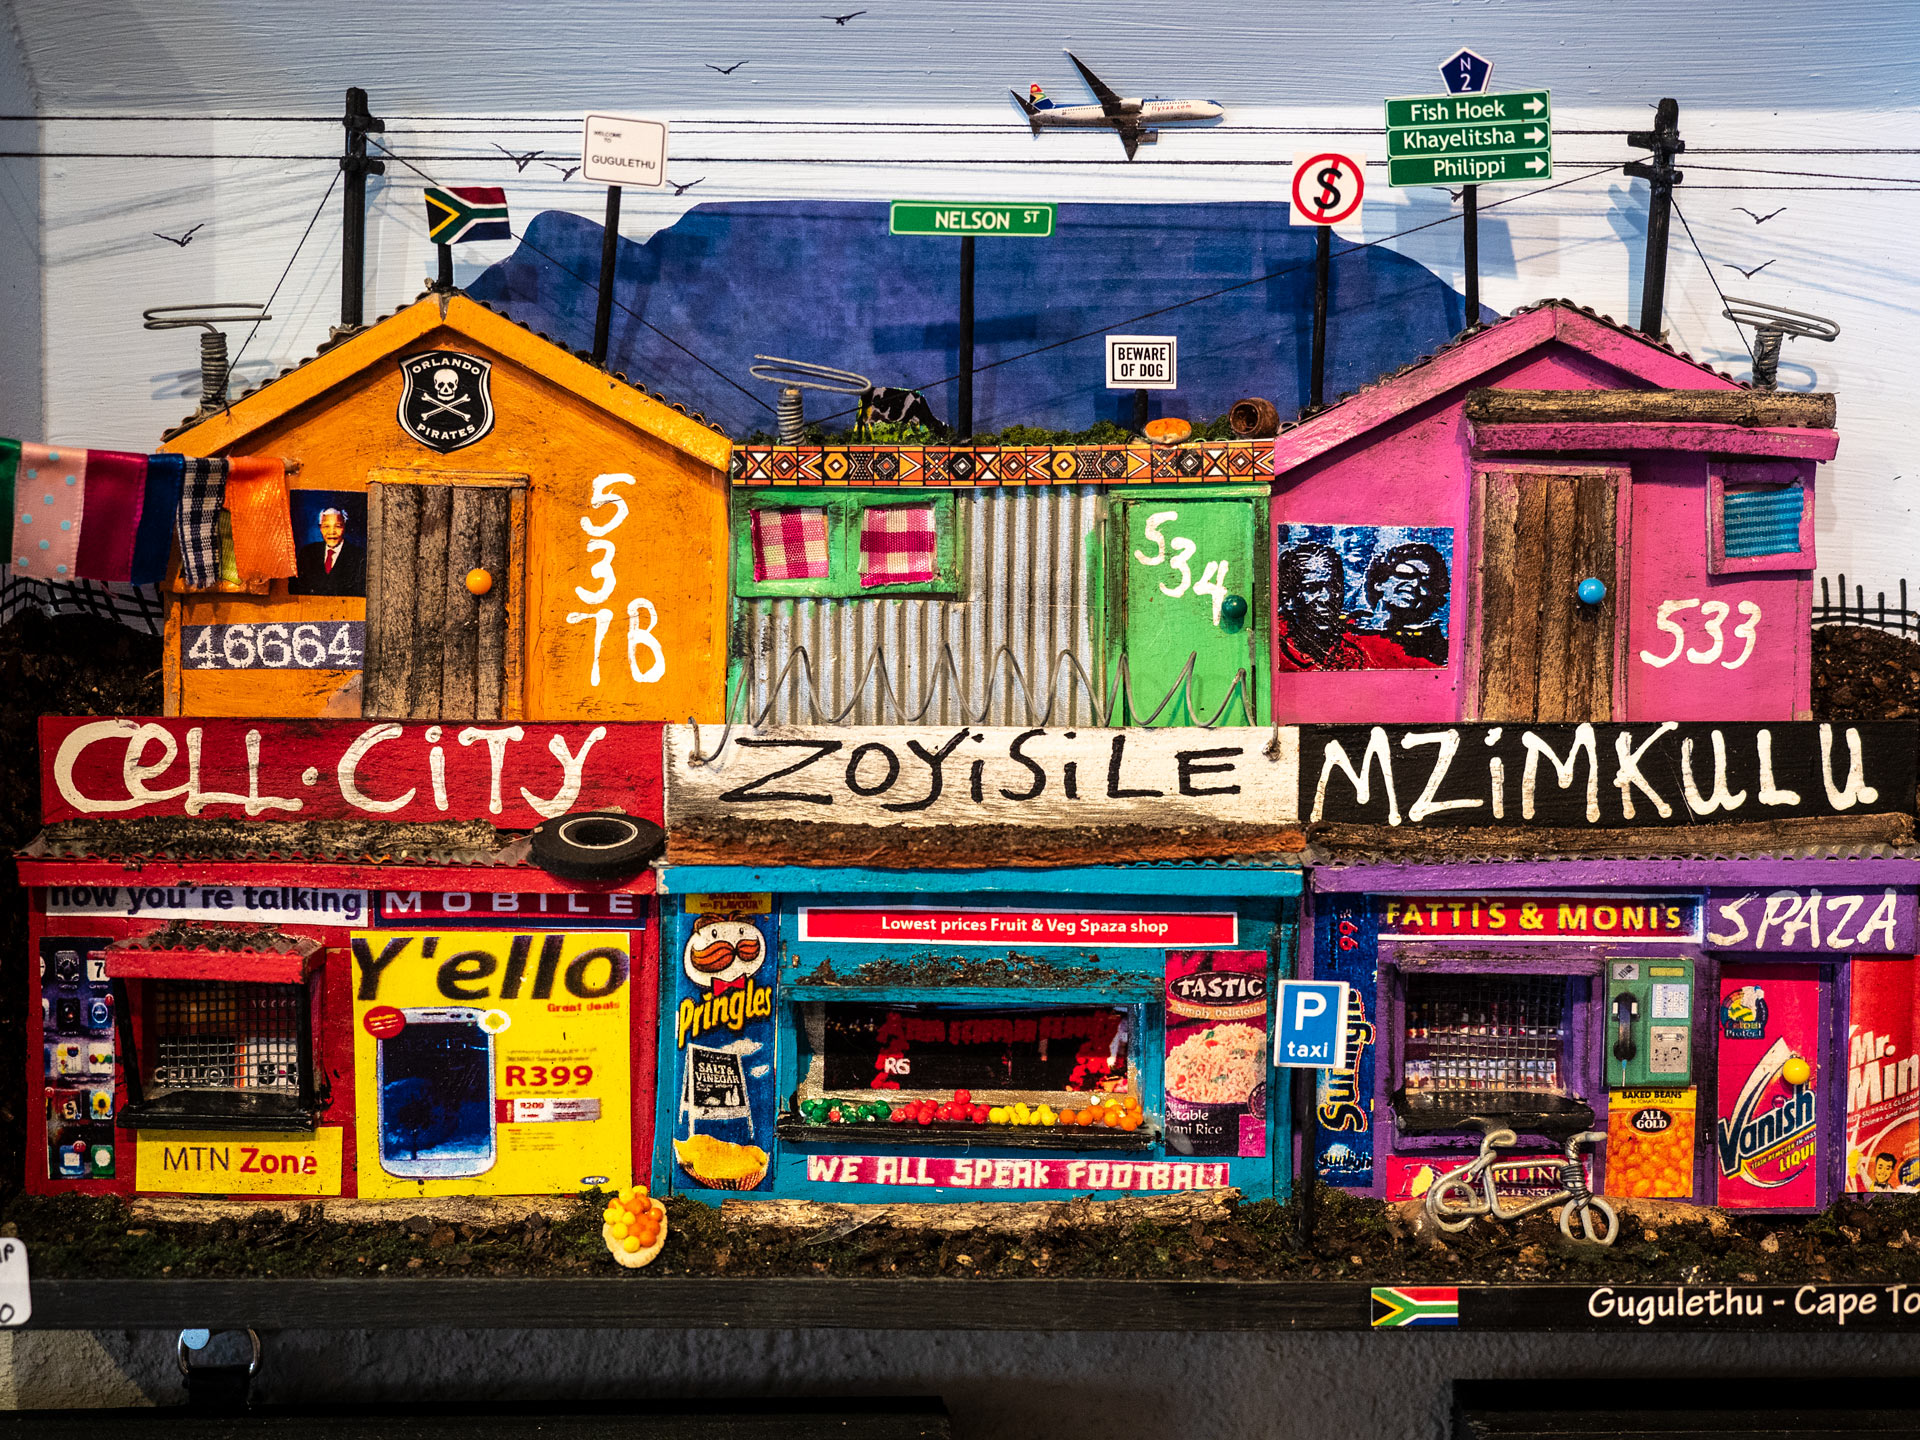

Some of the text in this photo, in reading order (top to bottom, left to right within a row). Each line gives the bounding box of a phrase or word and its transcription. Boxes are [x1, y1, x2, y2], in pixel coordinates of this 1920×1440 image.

[1459, 57, 1472, 72] N
[1460, 73, 1473, 91] 2
[1150, 103, 1192, 112] flysaa.com
[1410, 100, 1506, 121] Fish Hoek
[1403, 128, 1516, 152] Khayelitsha
[591, 155, 656, 170] GUGULETHU
[1433, 157, 1506, 178] Philippi
[1312, 167, 1343, 210] S
[935, 210, 1041, 230] NELSON ST
[1118, 347, 1166, 361] BEWARE
[412, 358, 480, 375] ORLANDO
[1121, 363, 1163, 377] OF DOG
[416, 423, 476, 440] PIRATES
[579, 473, 637, 537] 5
[574, 538, 618, 605] 3
[1133, 510, 1229, 627] 534
[1639, 598, 1762, 669] 533
[188, 622, 363, 669] 46664
[127, 886, 234, 915] you're
[243, 888, 361, 921] talking
[385, 891, 634, 914] MOBILE
[881, 915, 1168, 936] Lowest prices Fruit & Veg Spaza shop
[1518, 901, 1545, 930] &
[1706, 887, 1897, 951] SPAZA
[350, 935, 630, 1001] Y'ello
[1177, 977, 1263, 998] TASTIC
[546, 1000, 620, 1012] Great deals
[677, 978, 772, 1050] Pringles
[1176, 1004, 1261, 1018] Simply Delicious
[1294, 991, 1328, 1031] P
[1287, 1041, 1329, 1058] taxi
[1850, 1030, 1896, 1069] Mr.
[505, 1065, 593, 1087] R399
[884, 1057, 911, 1075] R6
[695, 1071, 740, 1084] VINEGAR
[1622, 1091, 1682, 1099] BAKED BEANS
[1636, 1119, 1667, 1129] GOLD
[1640, 1110, 1664, 1120] ALL
[1196, 1124, 1223, 1135] Rice
[1717, 1083, 1816, 1174] Vanish
[164, 1147, 318, 1175] MTN Zone
[809, 1156, 1228, 1191] WE ALL SPEAK FOOTBALL
[1587, 1286, 1763, 1325] Gugulethu
[1794, 1285, 1877, 1325] Cape
[1885, 1284, 1920, 1314] To
